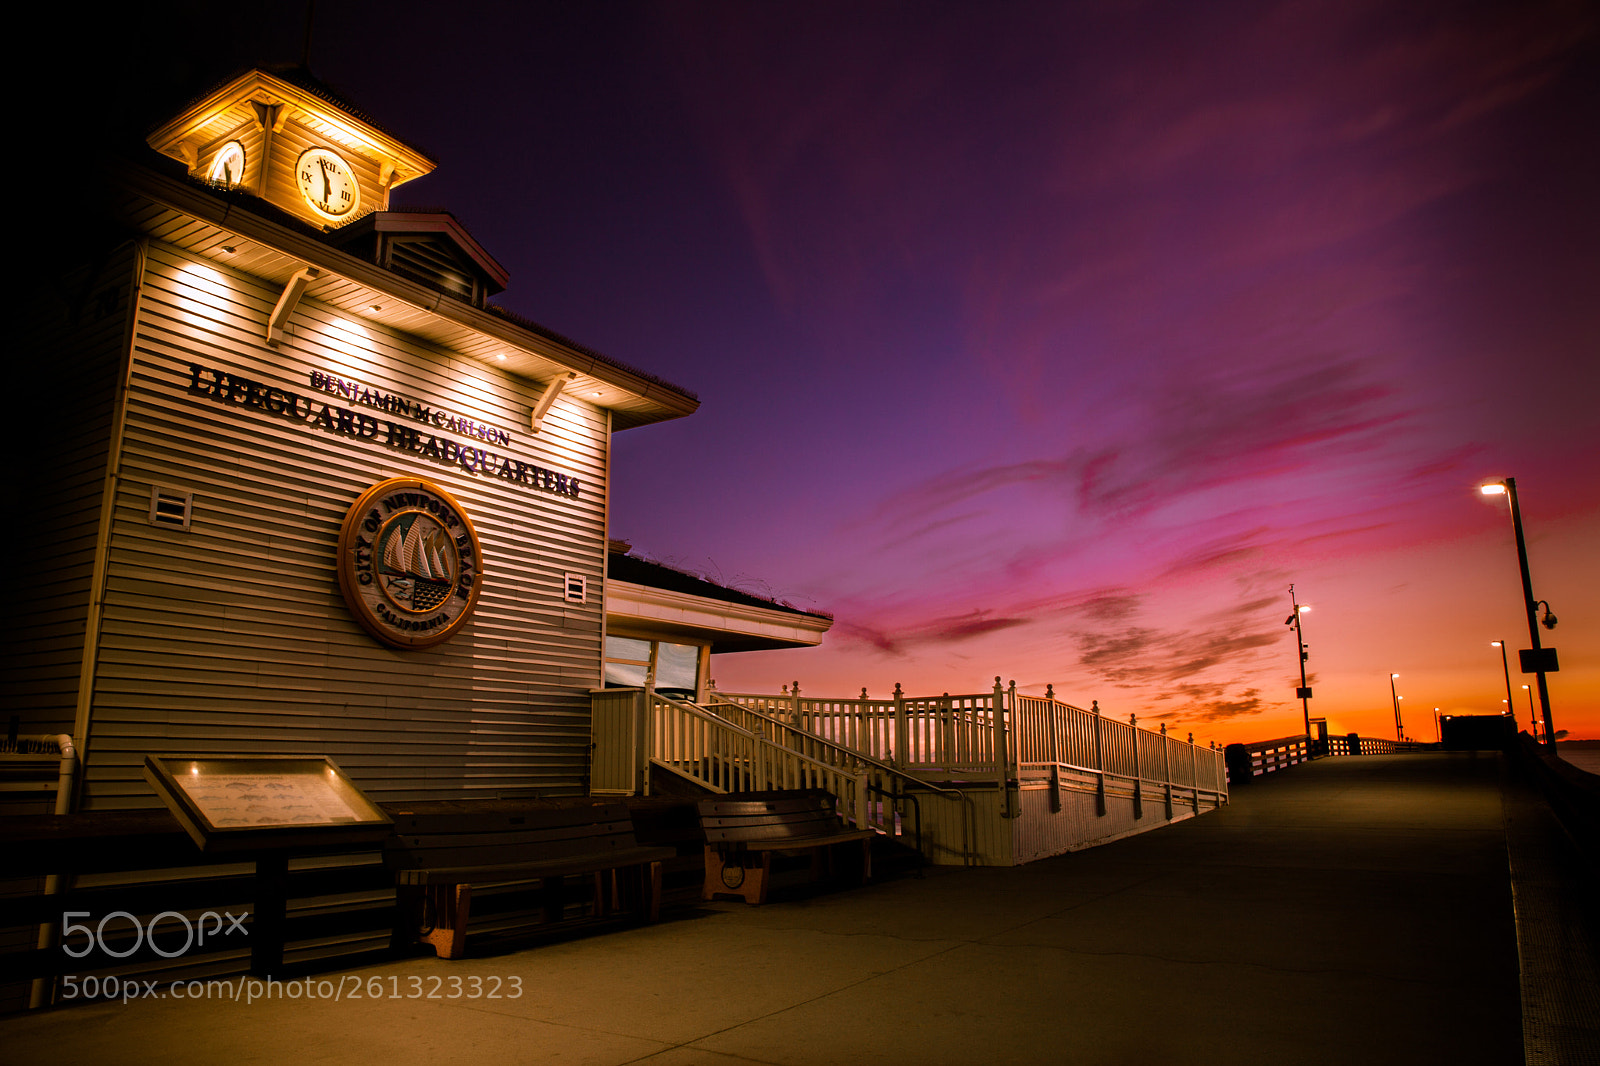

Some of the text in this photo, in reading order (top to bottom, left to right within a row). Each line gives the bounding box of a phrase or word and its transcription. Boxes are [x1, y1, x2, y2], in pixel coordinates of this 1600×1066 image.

[323, 158, 336, 173] XII
[301, 170, 313, 184] IX
[319, 201, 330, 213] VI
[340, 190, 352, 202] III
[310, 370, 411, 416] BENJAMIN
[433, 411, 510, 447] CARLSON
[188, 363, 581, 499] LIFEGUARD HEADQUARTERS
[355, 492, 473, 601] CITY OF NEWPORT BEACH
[376, 603, 451, 632] CALIFORNIA
